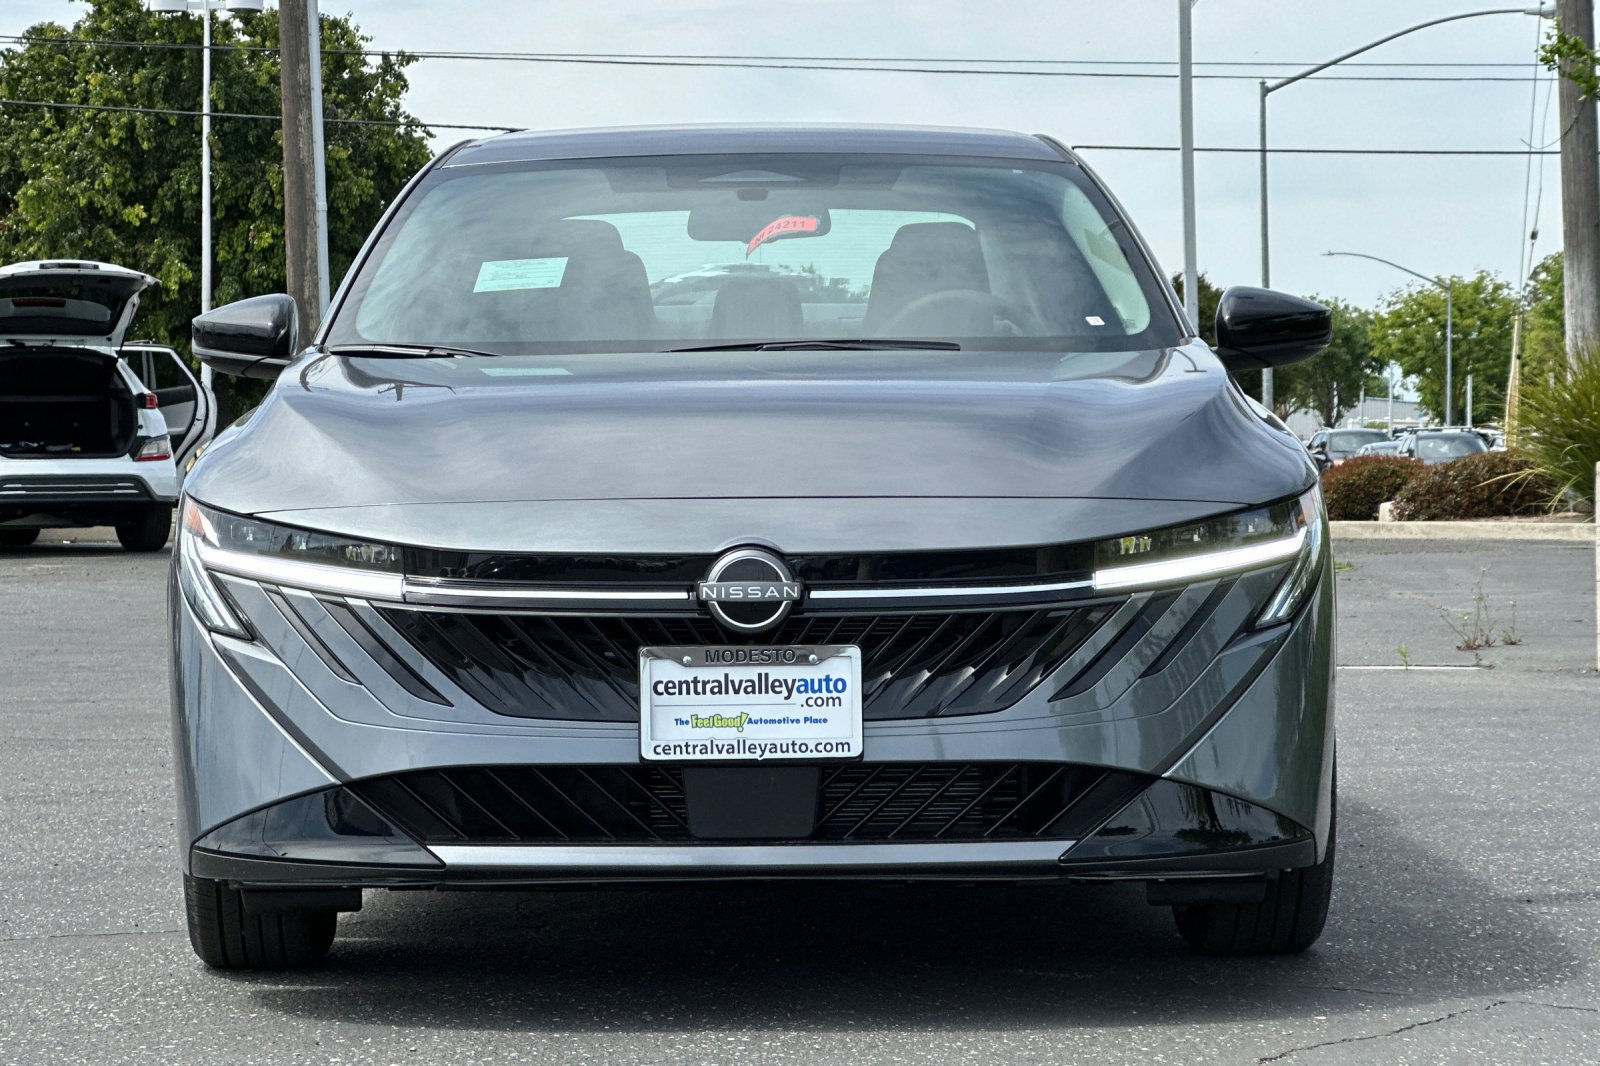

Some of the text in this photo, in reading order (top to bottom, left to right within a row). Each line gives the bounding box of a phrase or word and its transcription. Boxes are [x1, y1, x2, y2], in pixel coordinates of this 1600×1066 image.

[702, 586, 798, 598] NISSAN
[704, 649, 798, 664] MODESTO
[652, 672, 848, 700] centralvalleyauto
[800, 696, 842, 708] .com
[674, 718, 690, 726] The
[747, 716, 801, 725] Automotive
[803, 716, 828, 724] Place
[652, 738, 851, 758] centralvalleyauto.com
